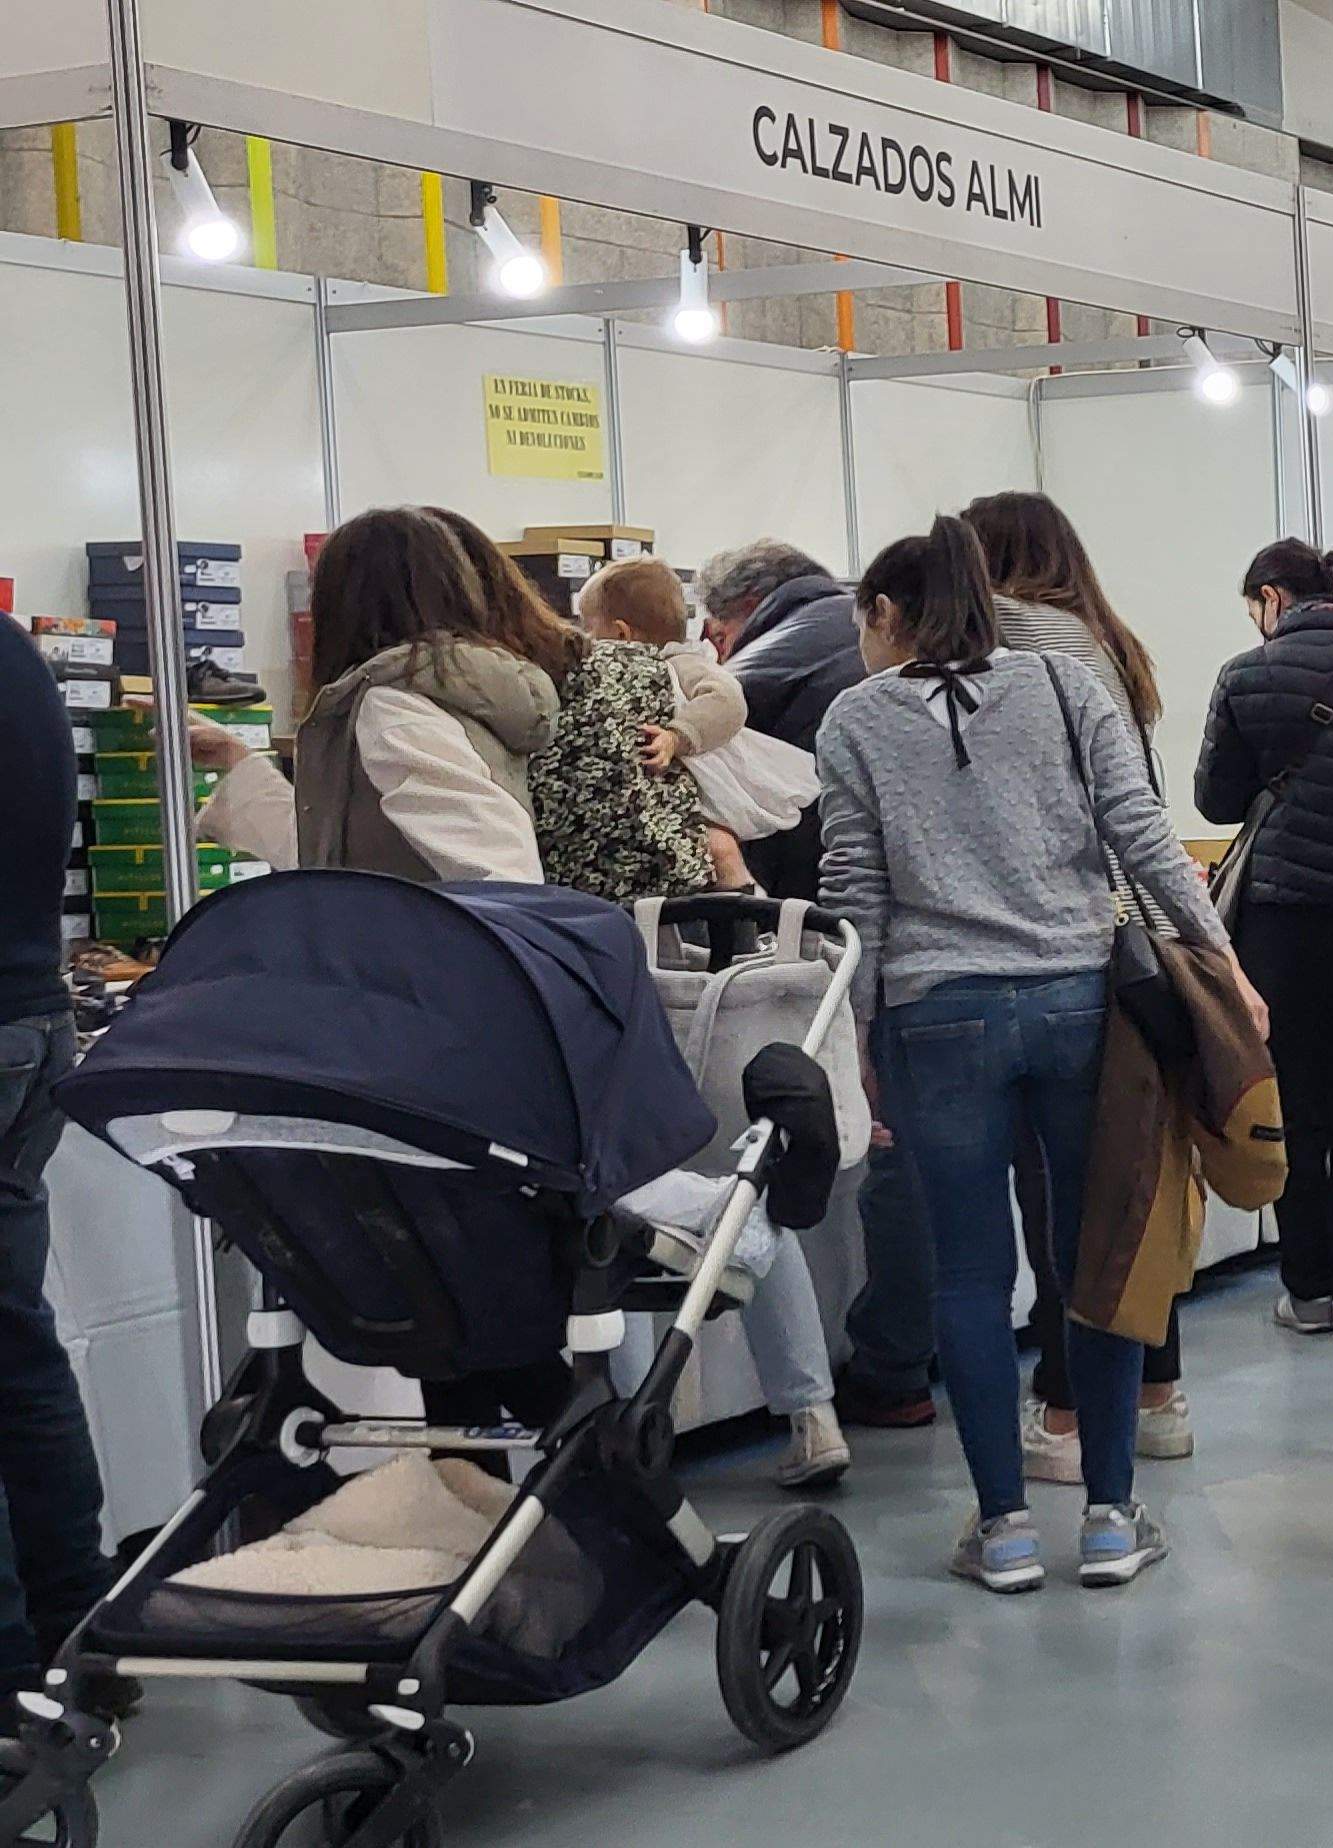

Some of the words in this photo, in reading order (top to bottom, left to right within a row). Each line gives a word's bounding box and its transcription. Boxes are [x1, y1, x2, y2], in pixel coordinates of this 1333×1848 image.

[753, 105, 956, 208] CALZADOS
[966, 160, 1042, 228] ALMI
[488, 403, 501, 419] NO
[502, 405, 515, 421] SE
[517, 406, 559, 425] ADMITEN
